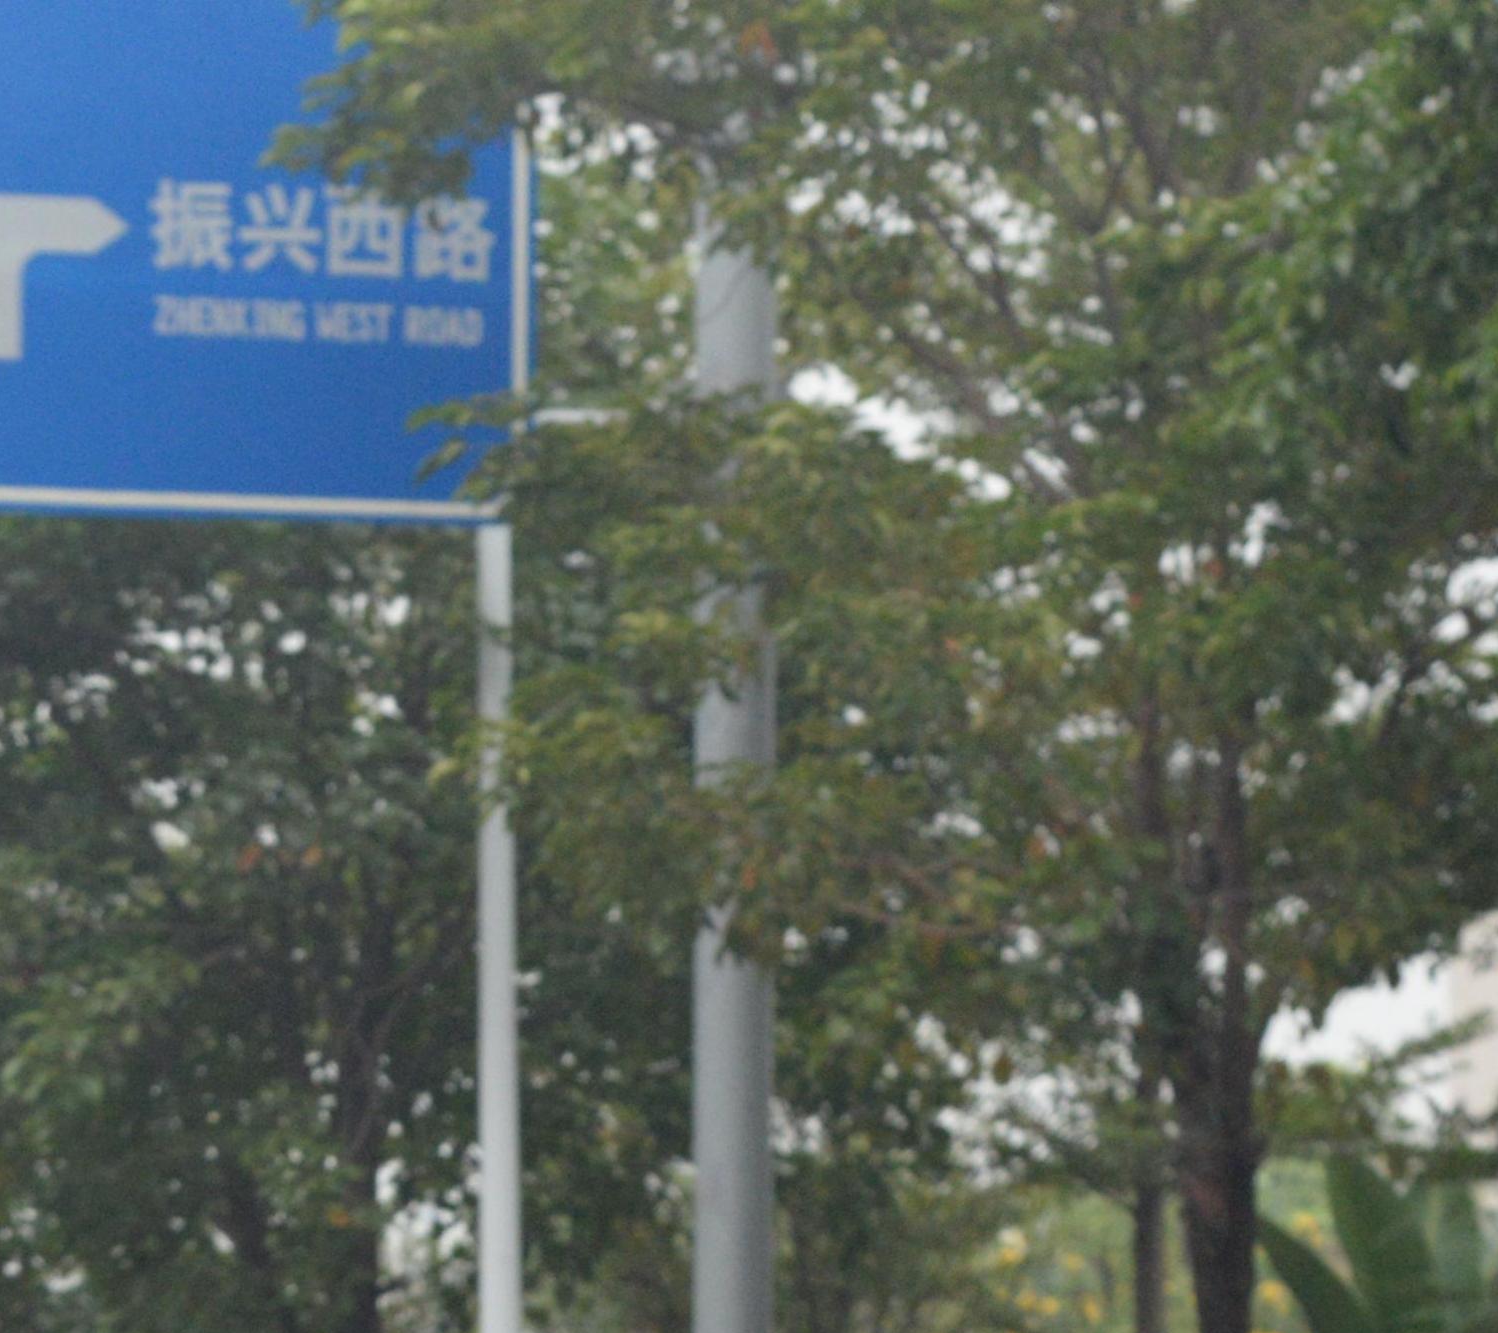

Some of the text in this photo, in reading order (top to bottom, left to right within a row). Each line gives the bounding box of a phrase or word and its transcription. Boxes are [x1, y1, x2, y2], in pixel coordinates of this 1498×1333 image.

[150, 178, 495, 282] 振兴西路
[314, 302, 393, 342] WEST
[404, 305, 485, 348] ROAD
